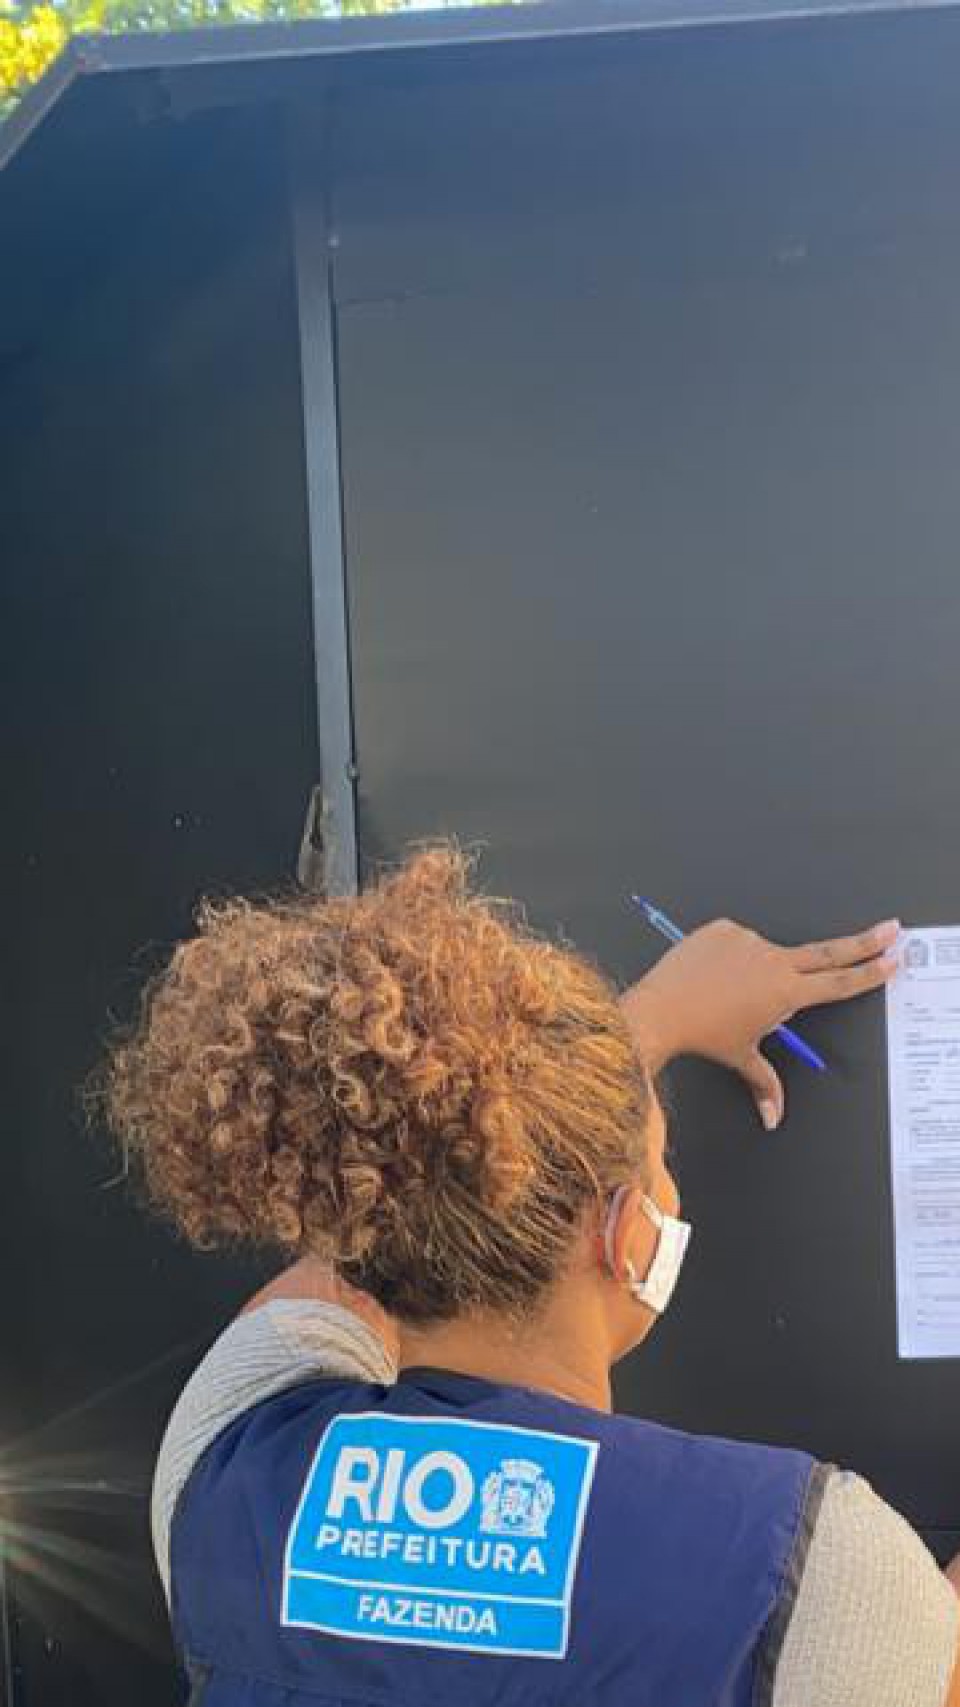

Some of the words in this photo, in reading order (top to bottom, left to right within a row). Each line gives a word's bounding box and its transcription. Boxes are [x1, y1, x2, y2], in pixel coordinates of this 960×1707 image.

[325, 1446, 475, 1529] RIO
[316, 1524, 547, 1575] PREFEITURA
[357, 1594, 498, 1635] FAZENDA
